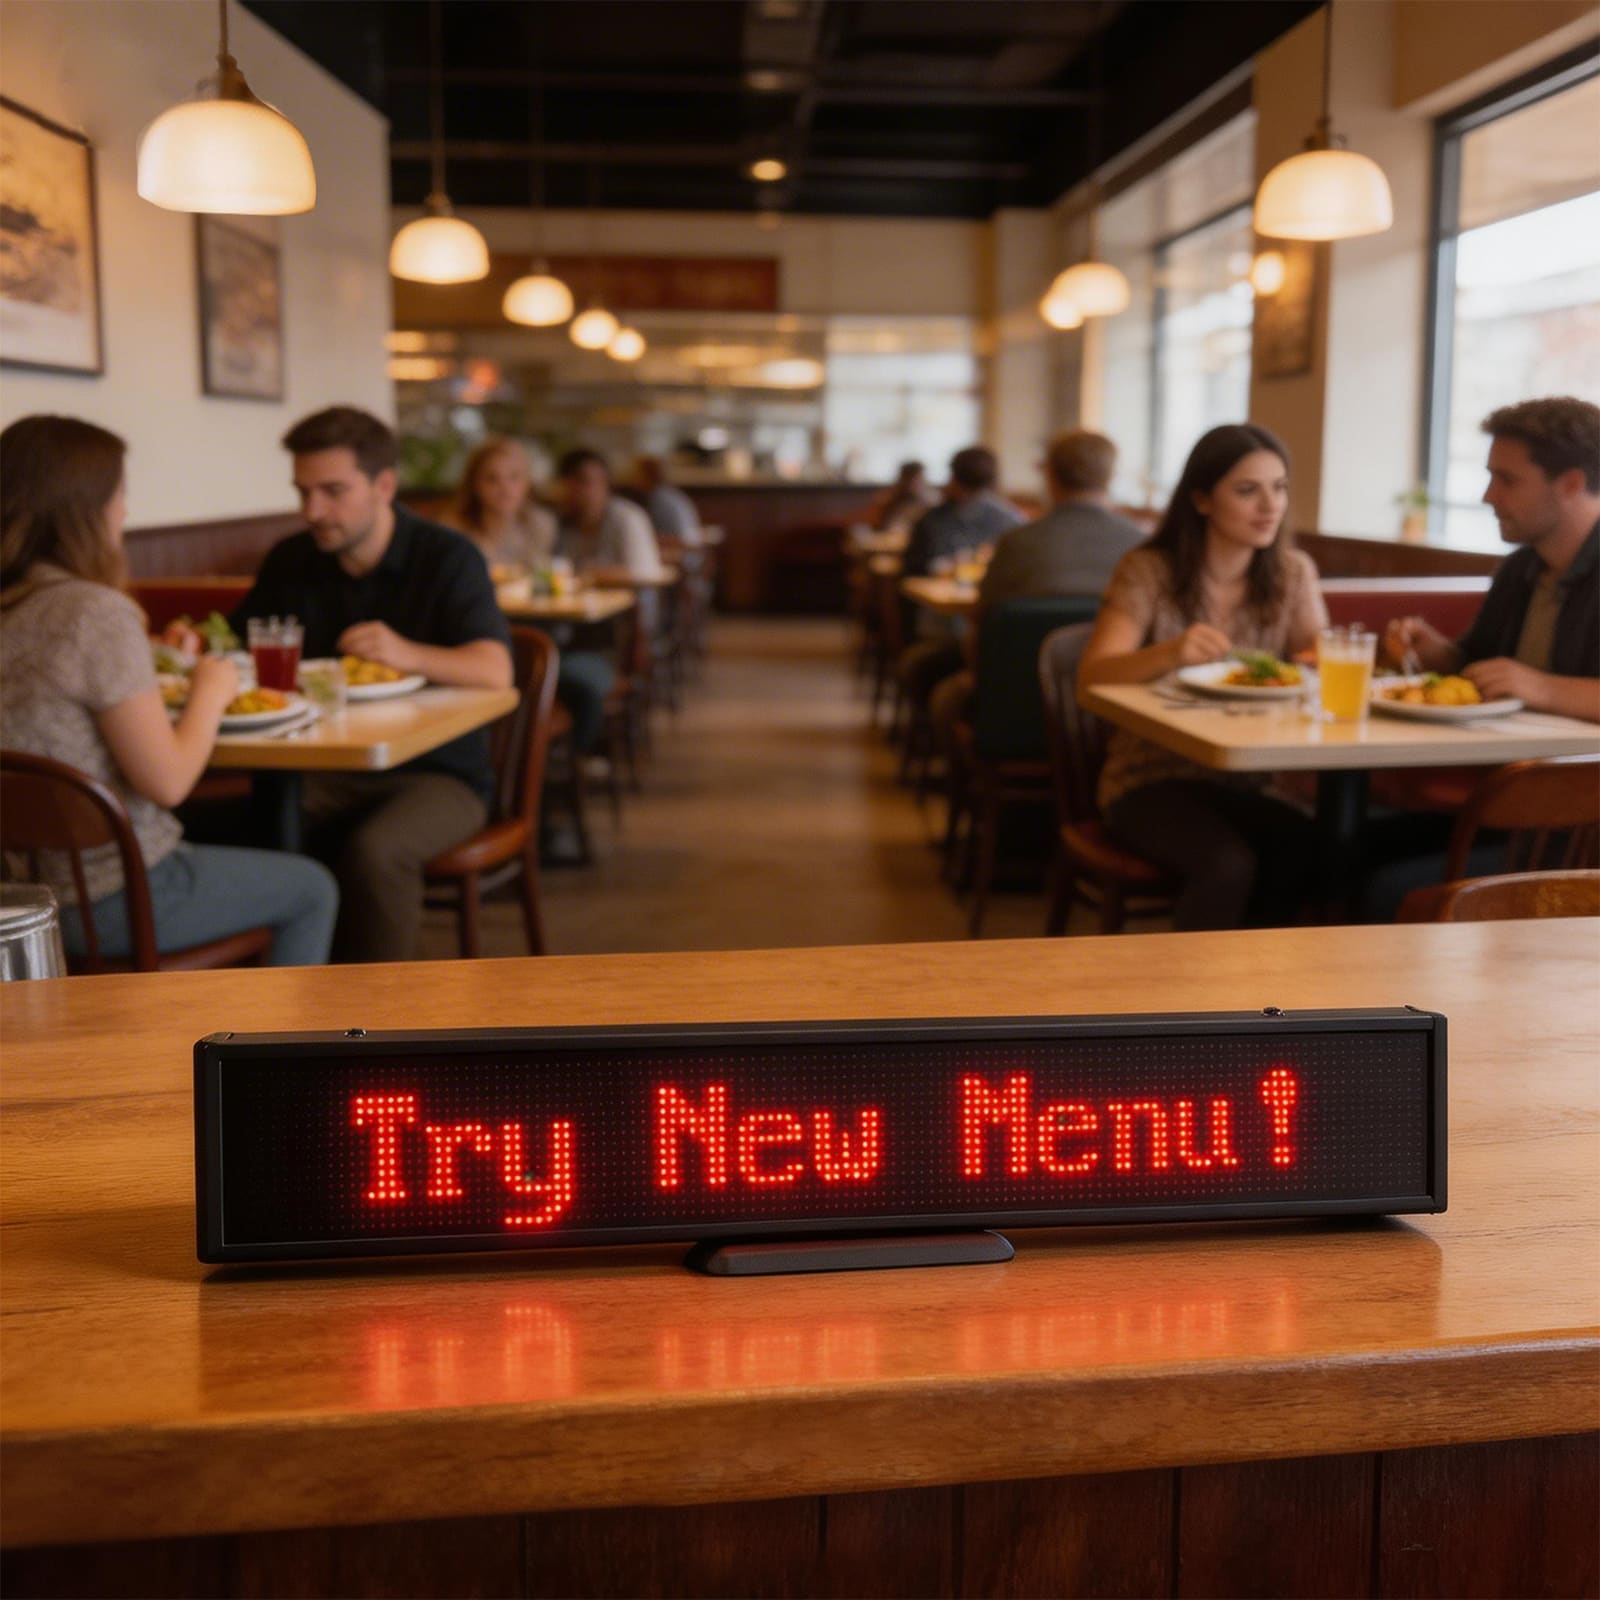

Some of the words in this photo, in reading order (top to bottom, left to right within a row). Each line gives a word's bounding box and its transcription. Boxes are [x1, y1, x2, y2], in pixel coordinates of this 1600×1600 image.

[351, 1094, 575, 1226] Try
[654, 1084, 880, 1189] New
[959, 1069, 1297, 1177] Menu!
